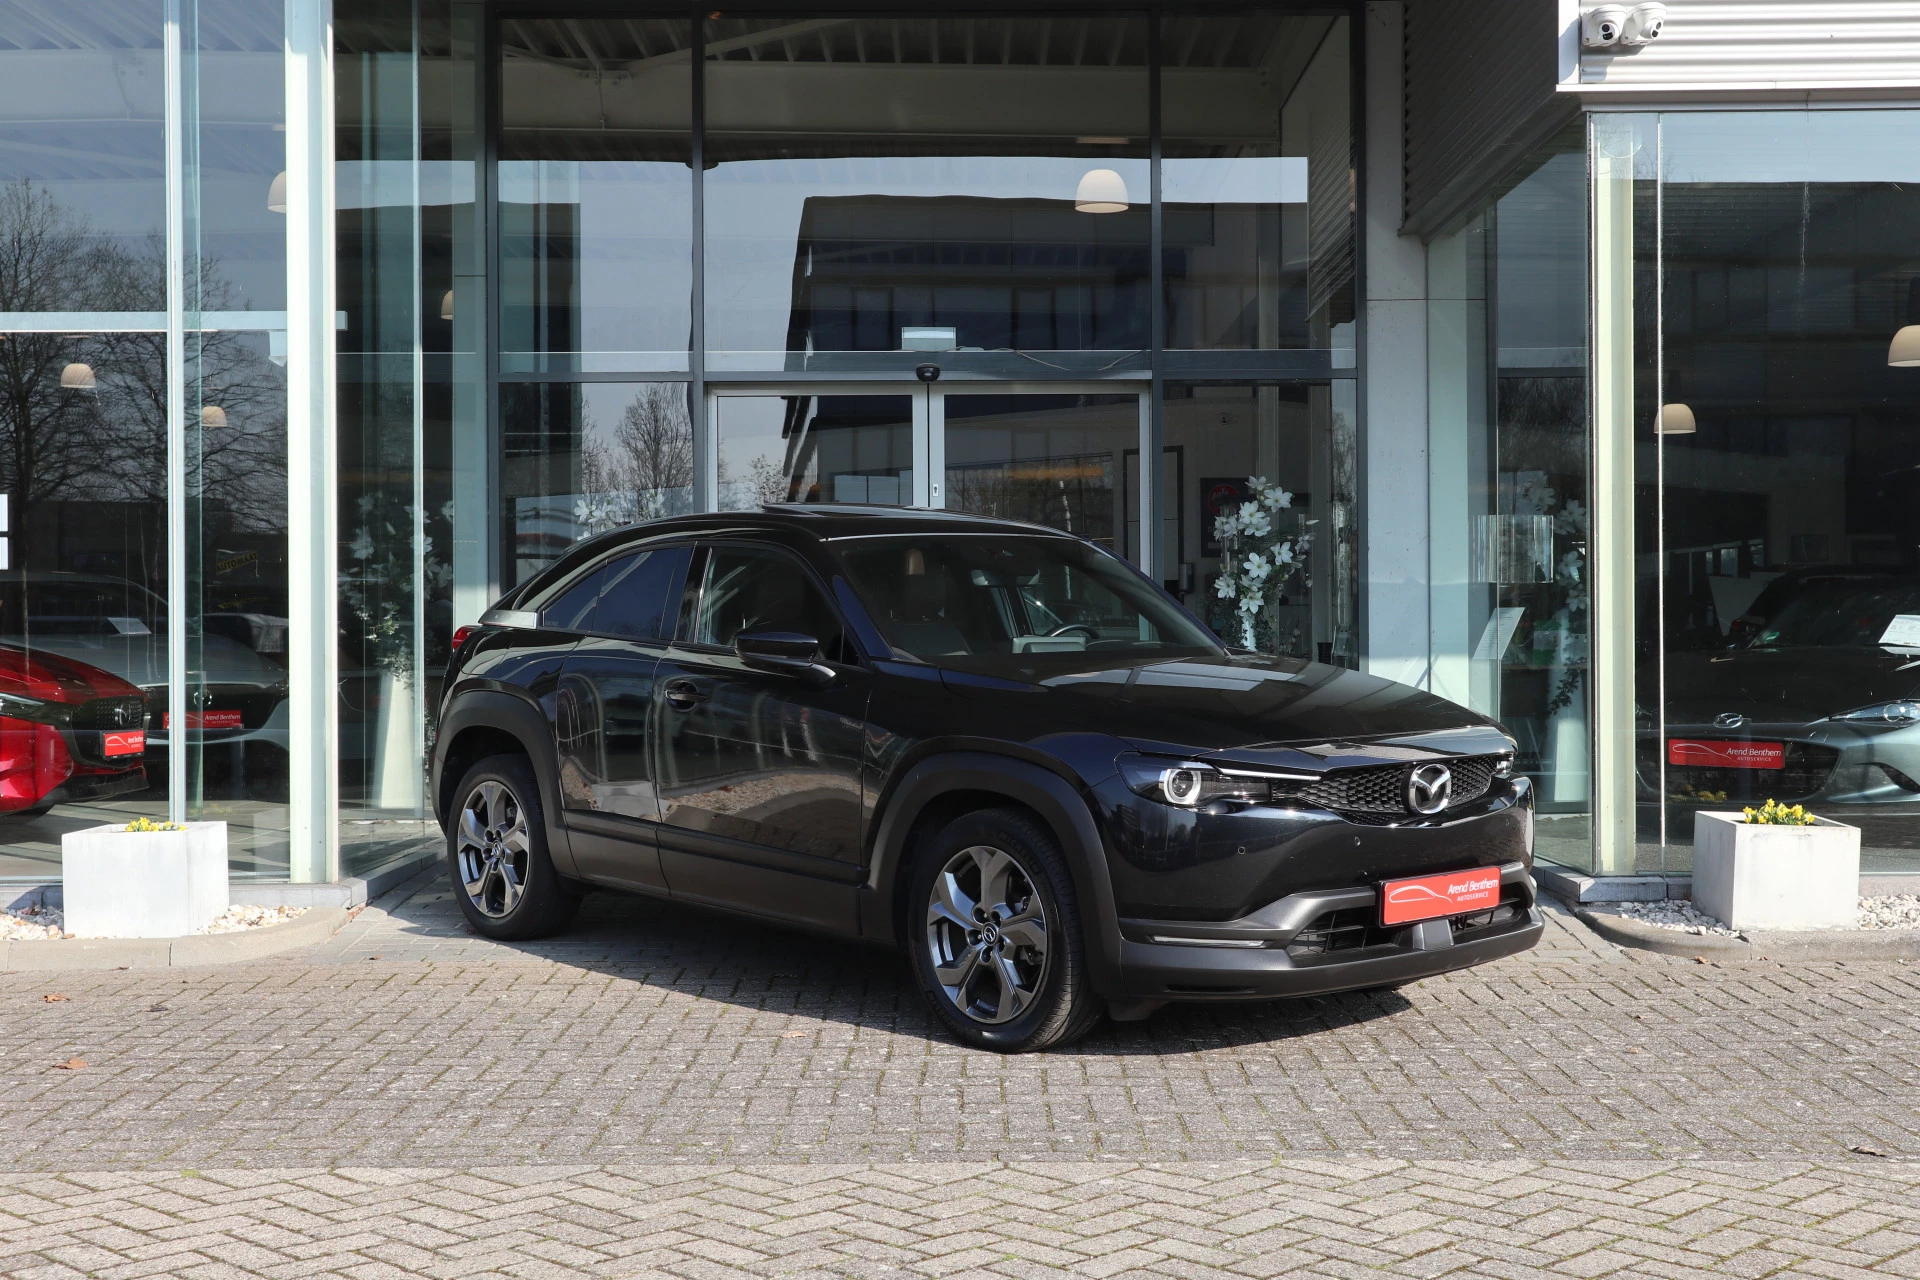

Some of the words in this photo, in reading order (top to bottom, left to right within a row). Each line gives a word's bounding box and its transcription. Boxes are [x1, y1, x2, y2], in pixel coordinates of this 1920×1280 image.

[217, 552, 257, 573] AUTOMAAT
[1727, 747, 1748, 755] Arend
[1749, 748, 1781, 756] Benthem
[1447, 881, 1469, 895] Arend
[1469, 878, 1498, 891] Benthem
[1457, 891, 1489, 901] AUTOSERVICE
